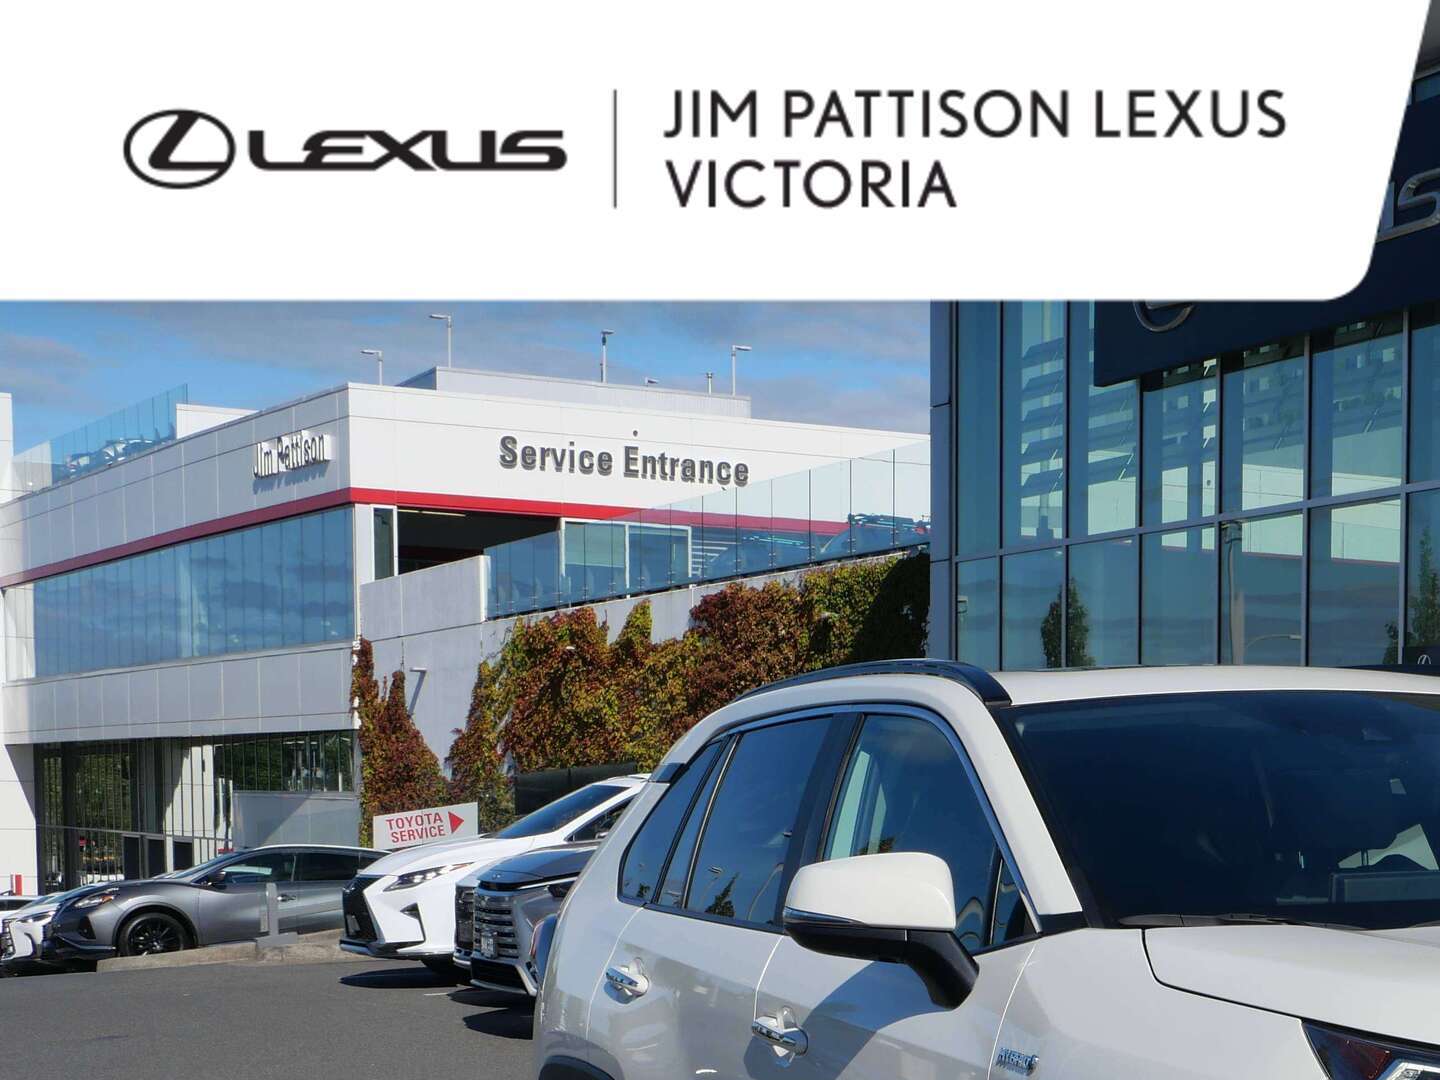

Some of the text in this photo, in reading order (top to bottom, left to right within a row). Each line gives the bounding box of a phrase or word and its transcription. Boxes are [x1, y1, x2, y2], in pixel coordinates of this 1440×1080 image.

[276, 433, 329, 473] Pattison
[500, 435, 750, 487] Service Entrance
[386, 812, 443, 831] TOYOTA
[391, 825, 446, 844] SERVICE
